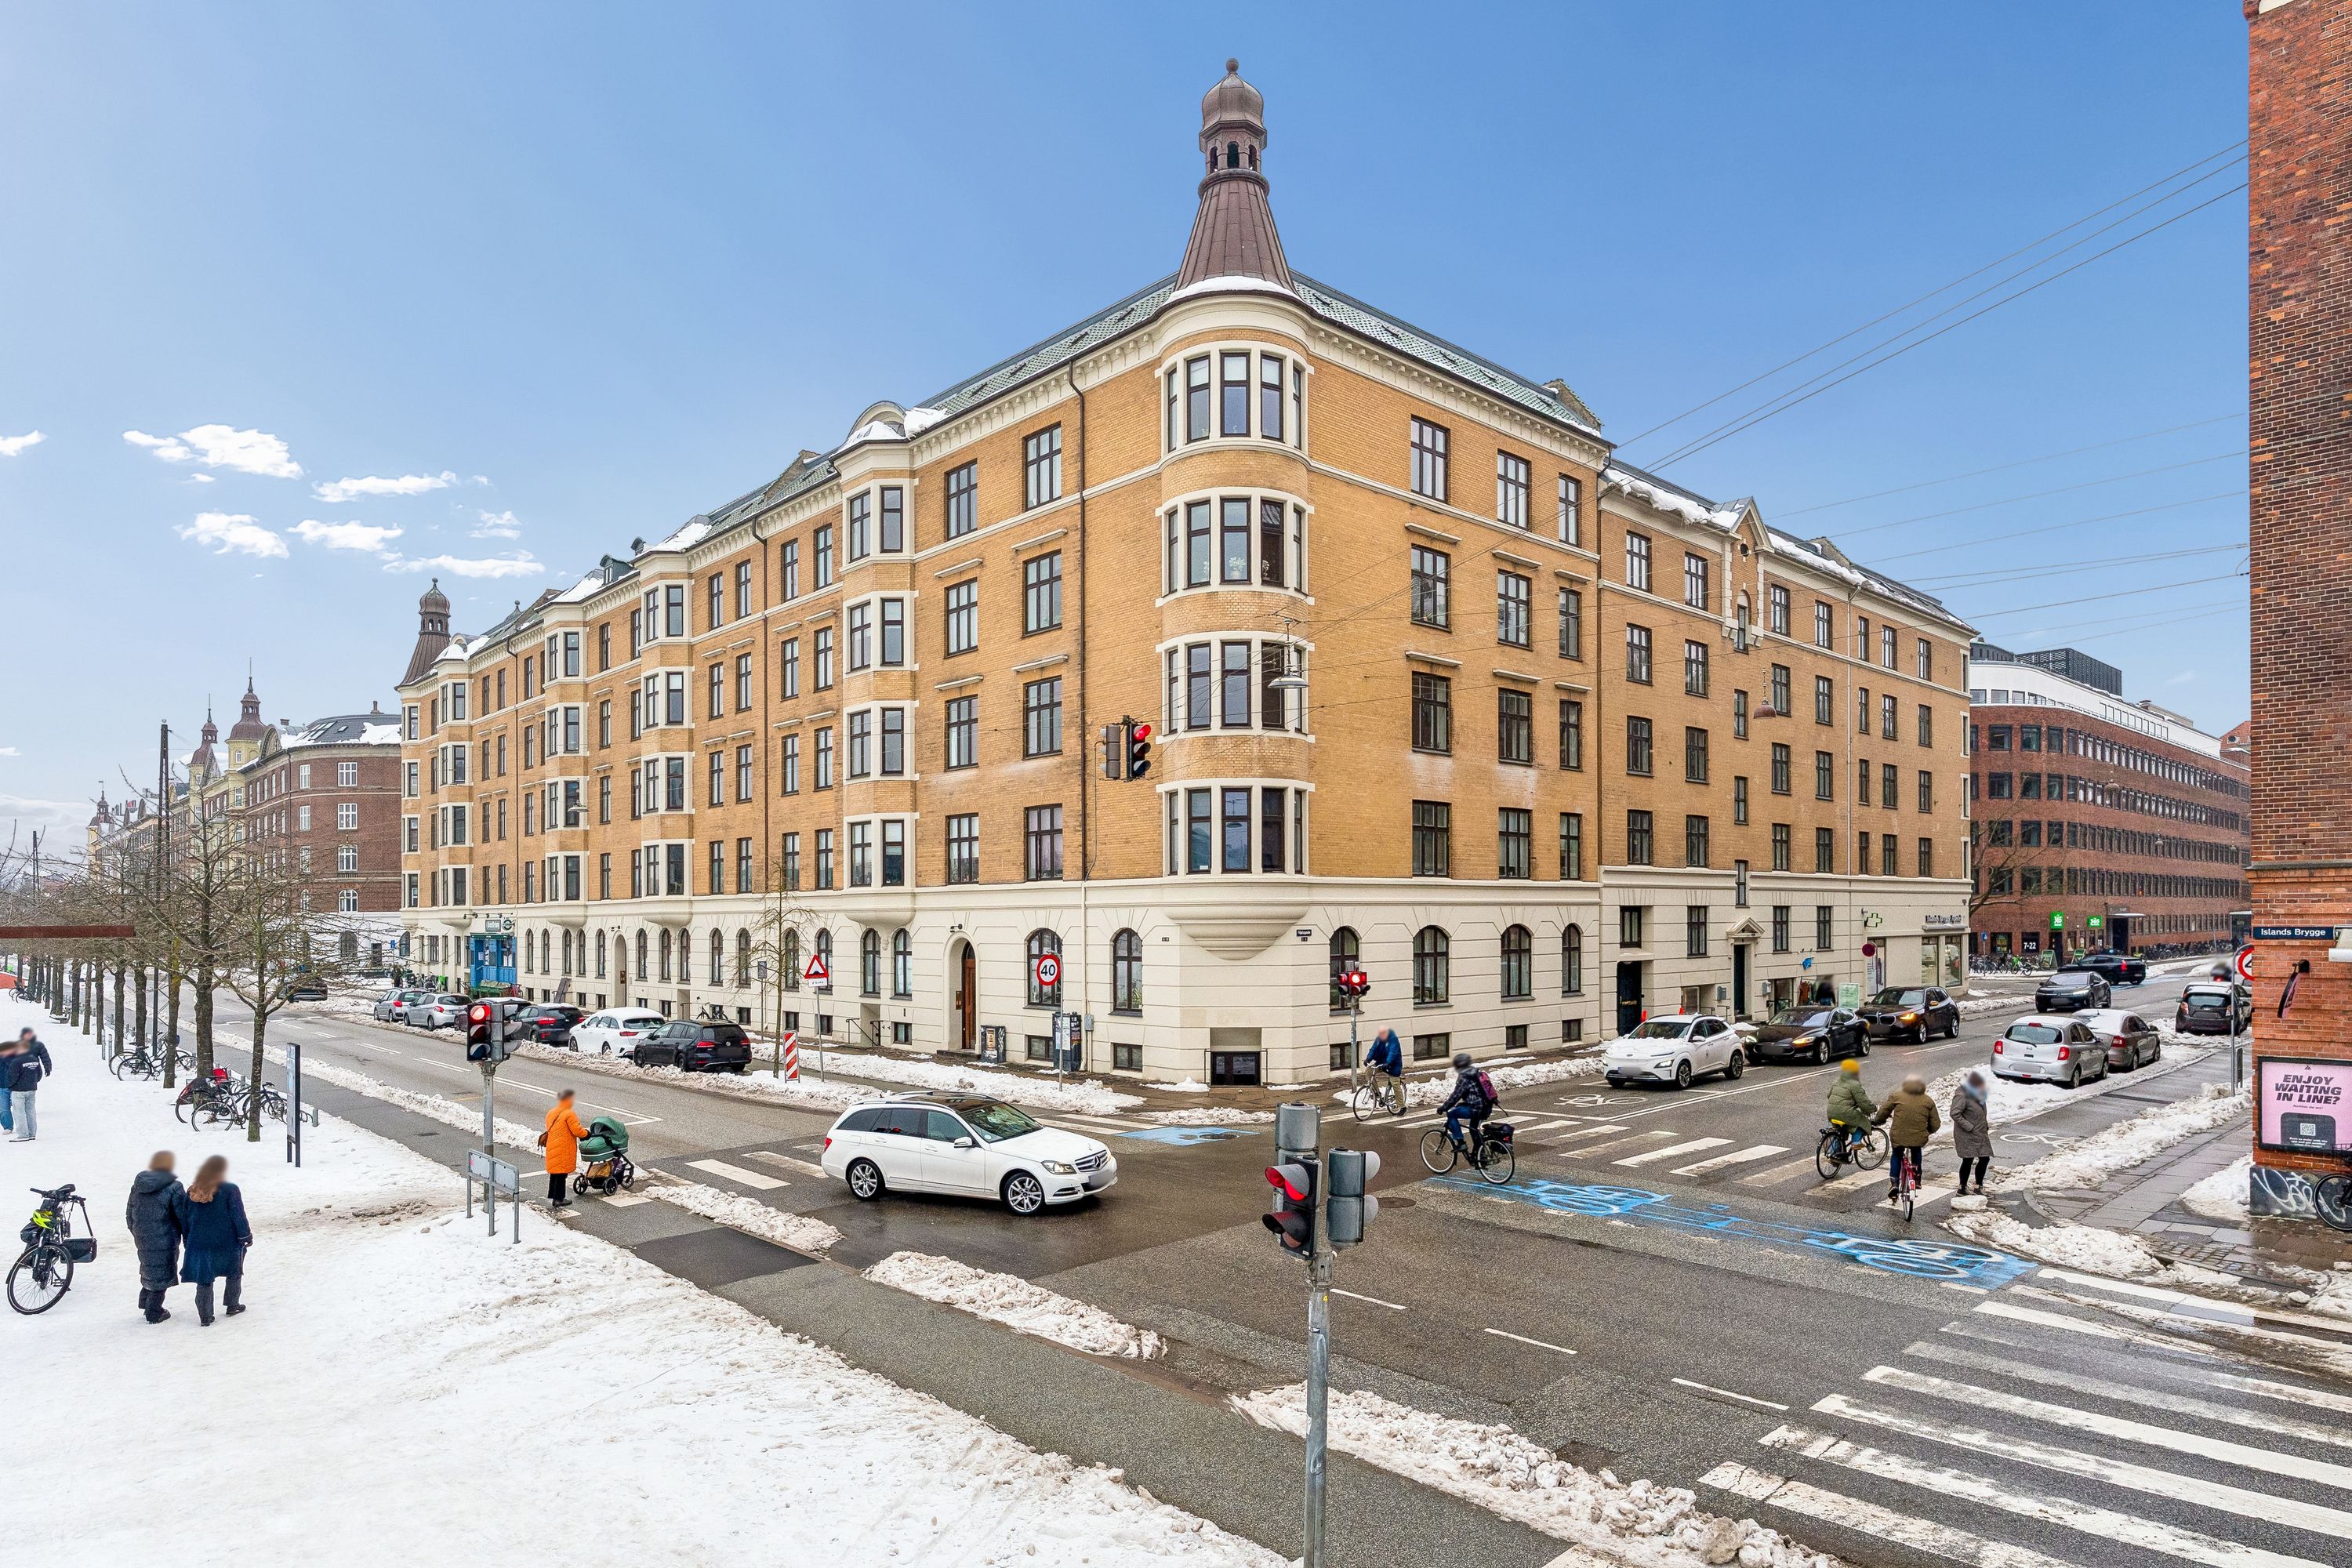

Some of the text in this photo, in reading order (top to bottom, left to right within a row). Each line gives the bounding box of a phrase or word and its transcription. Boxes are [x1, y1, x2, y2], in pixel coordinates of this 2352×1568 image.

[2294, 928, 2326, 937] Brygge
[1040, 964, 1056, 976] 40
[2282, 1074, 2334, 1085] ENJOY
[2274, 1083, 2343, 1095] WAITING
[2276, 1092, 2340, 1105] IN LINE?
